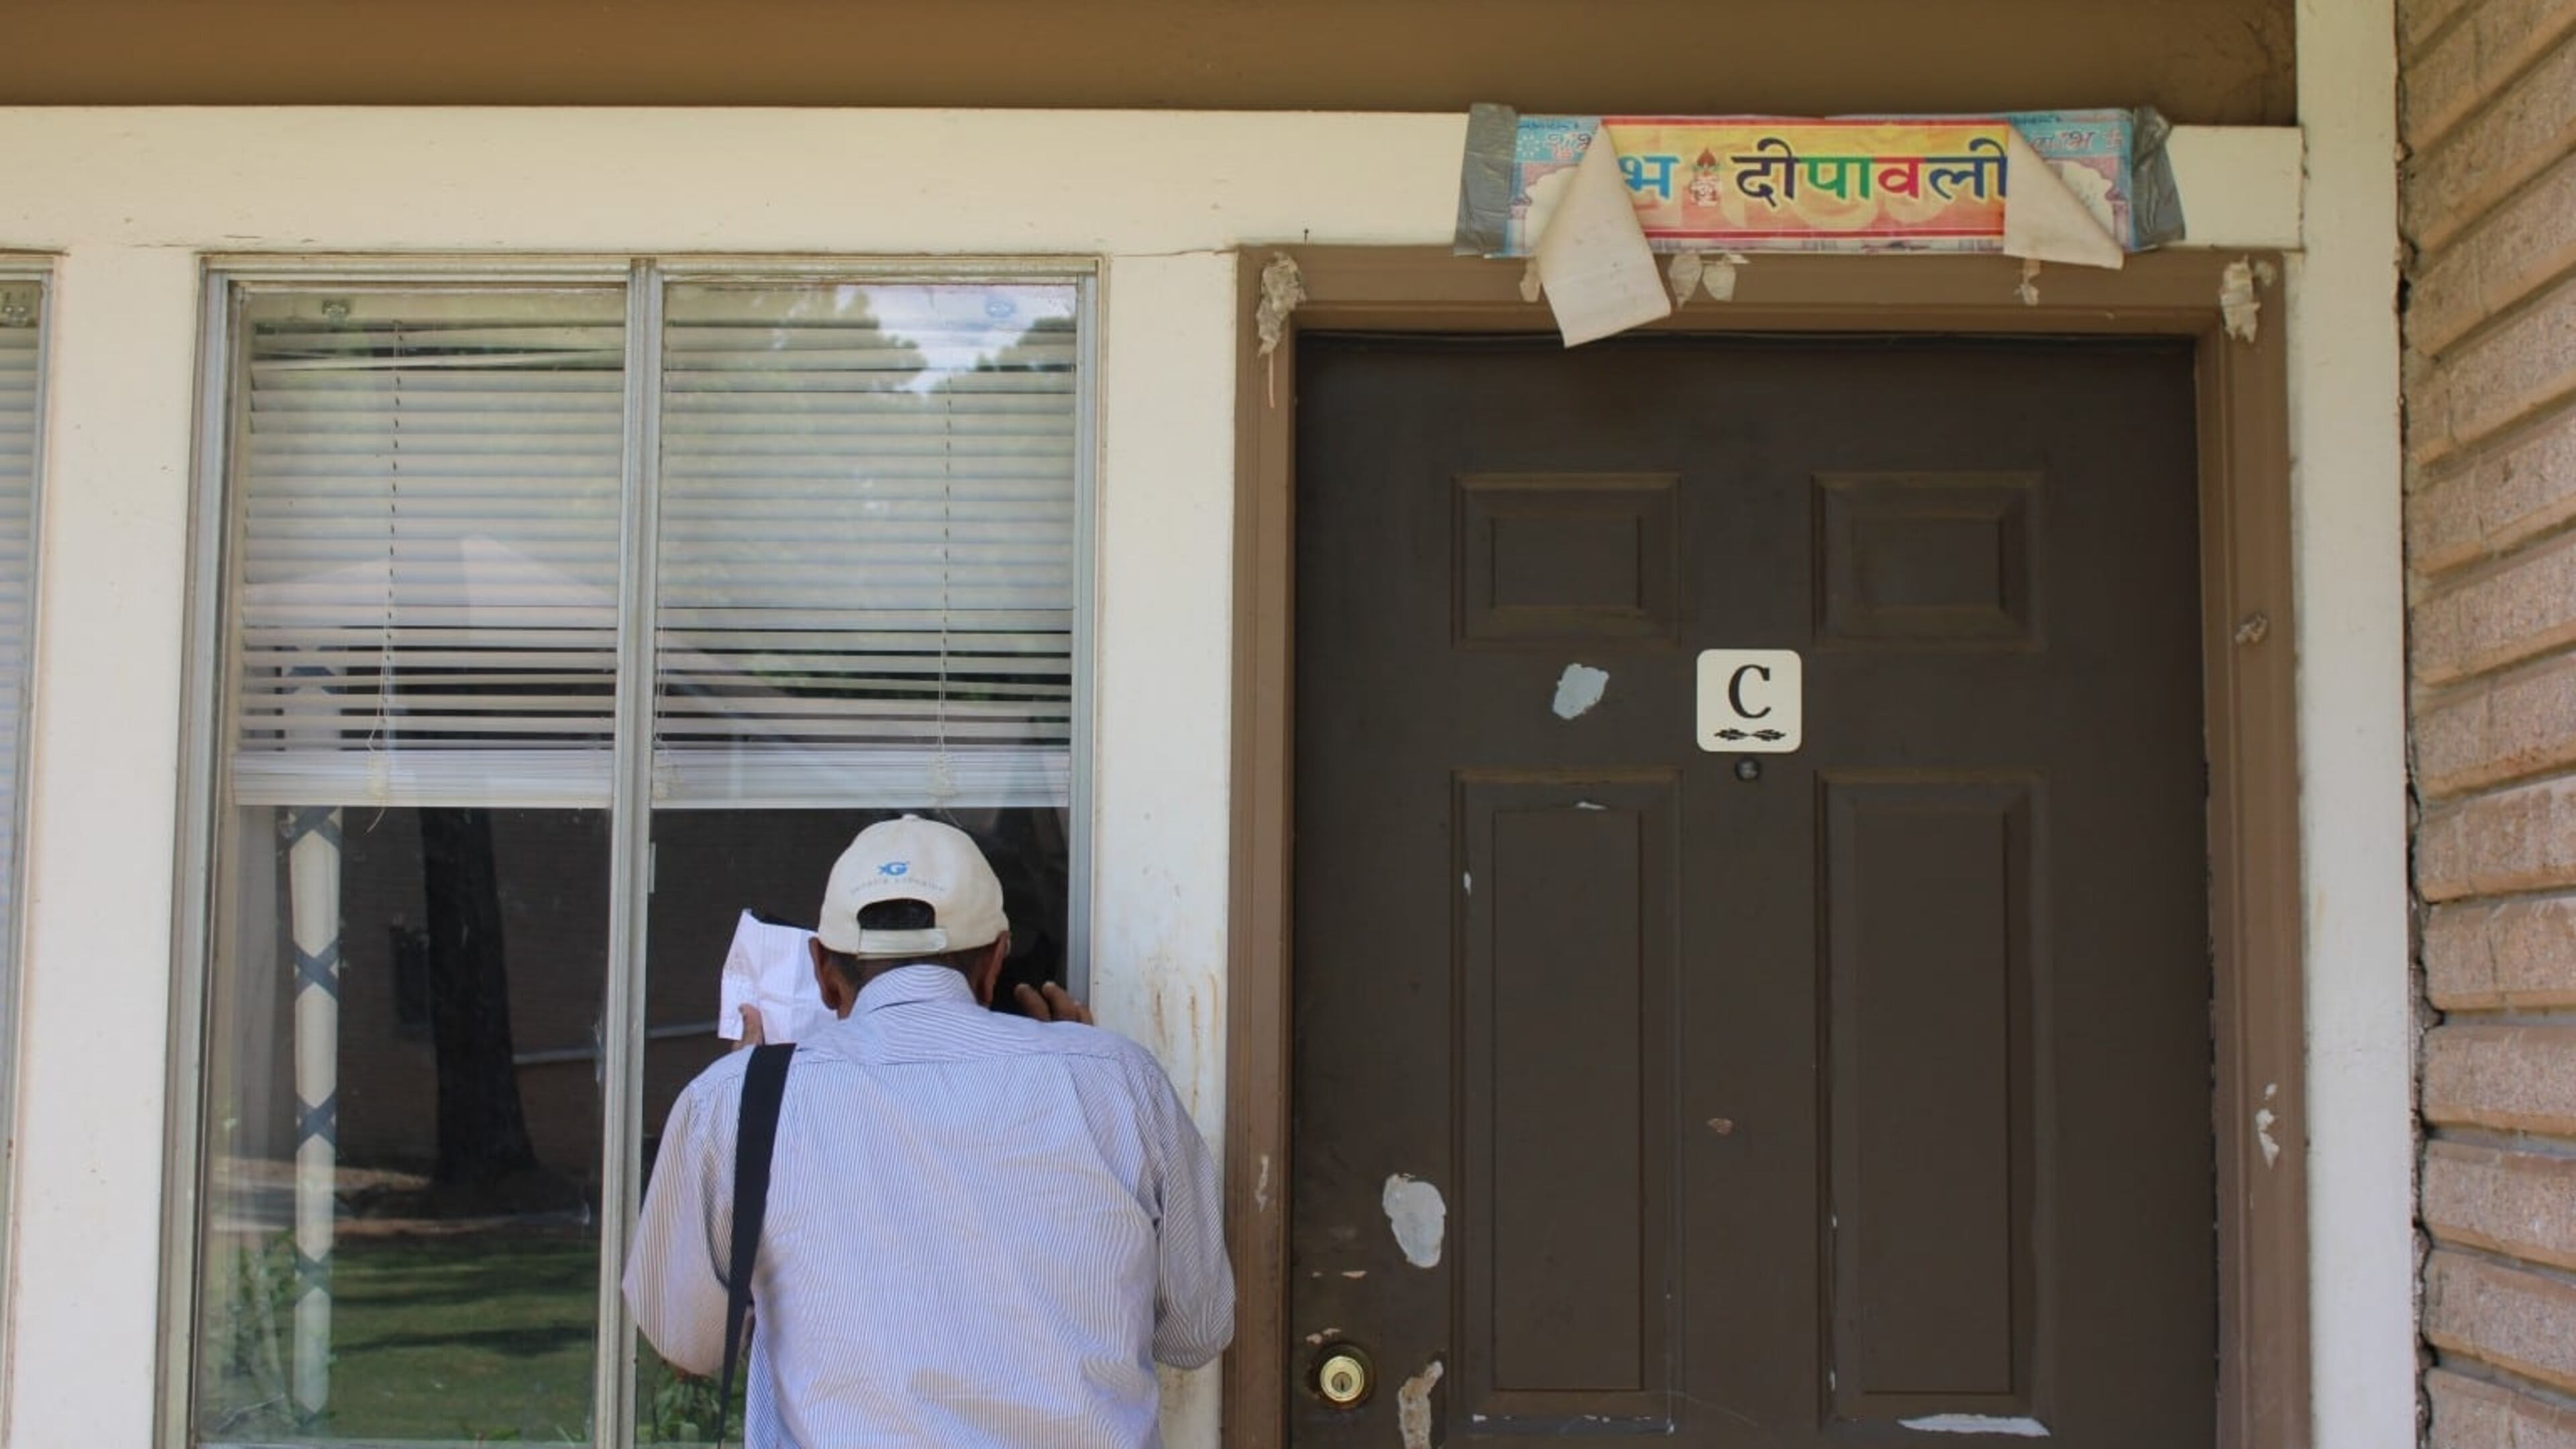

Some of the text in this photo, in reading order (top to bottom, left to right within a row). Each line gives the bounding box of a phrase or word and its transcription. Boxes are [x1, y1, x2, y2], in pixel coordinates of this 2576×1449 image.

[1617, 137, 2007, 207] भ दीपावली
[1728, 664, 1772, 719] C
